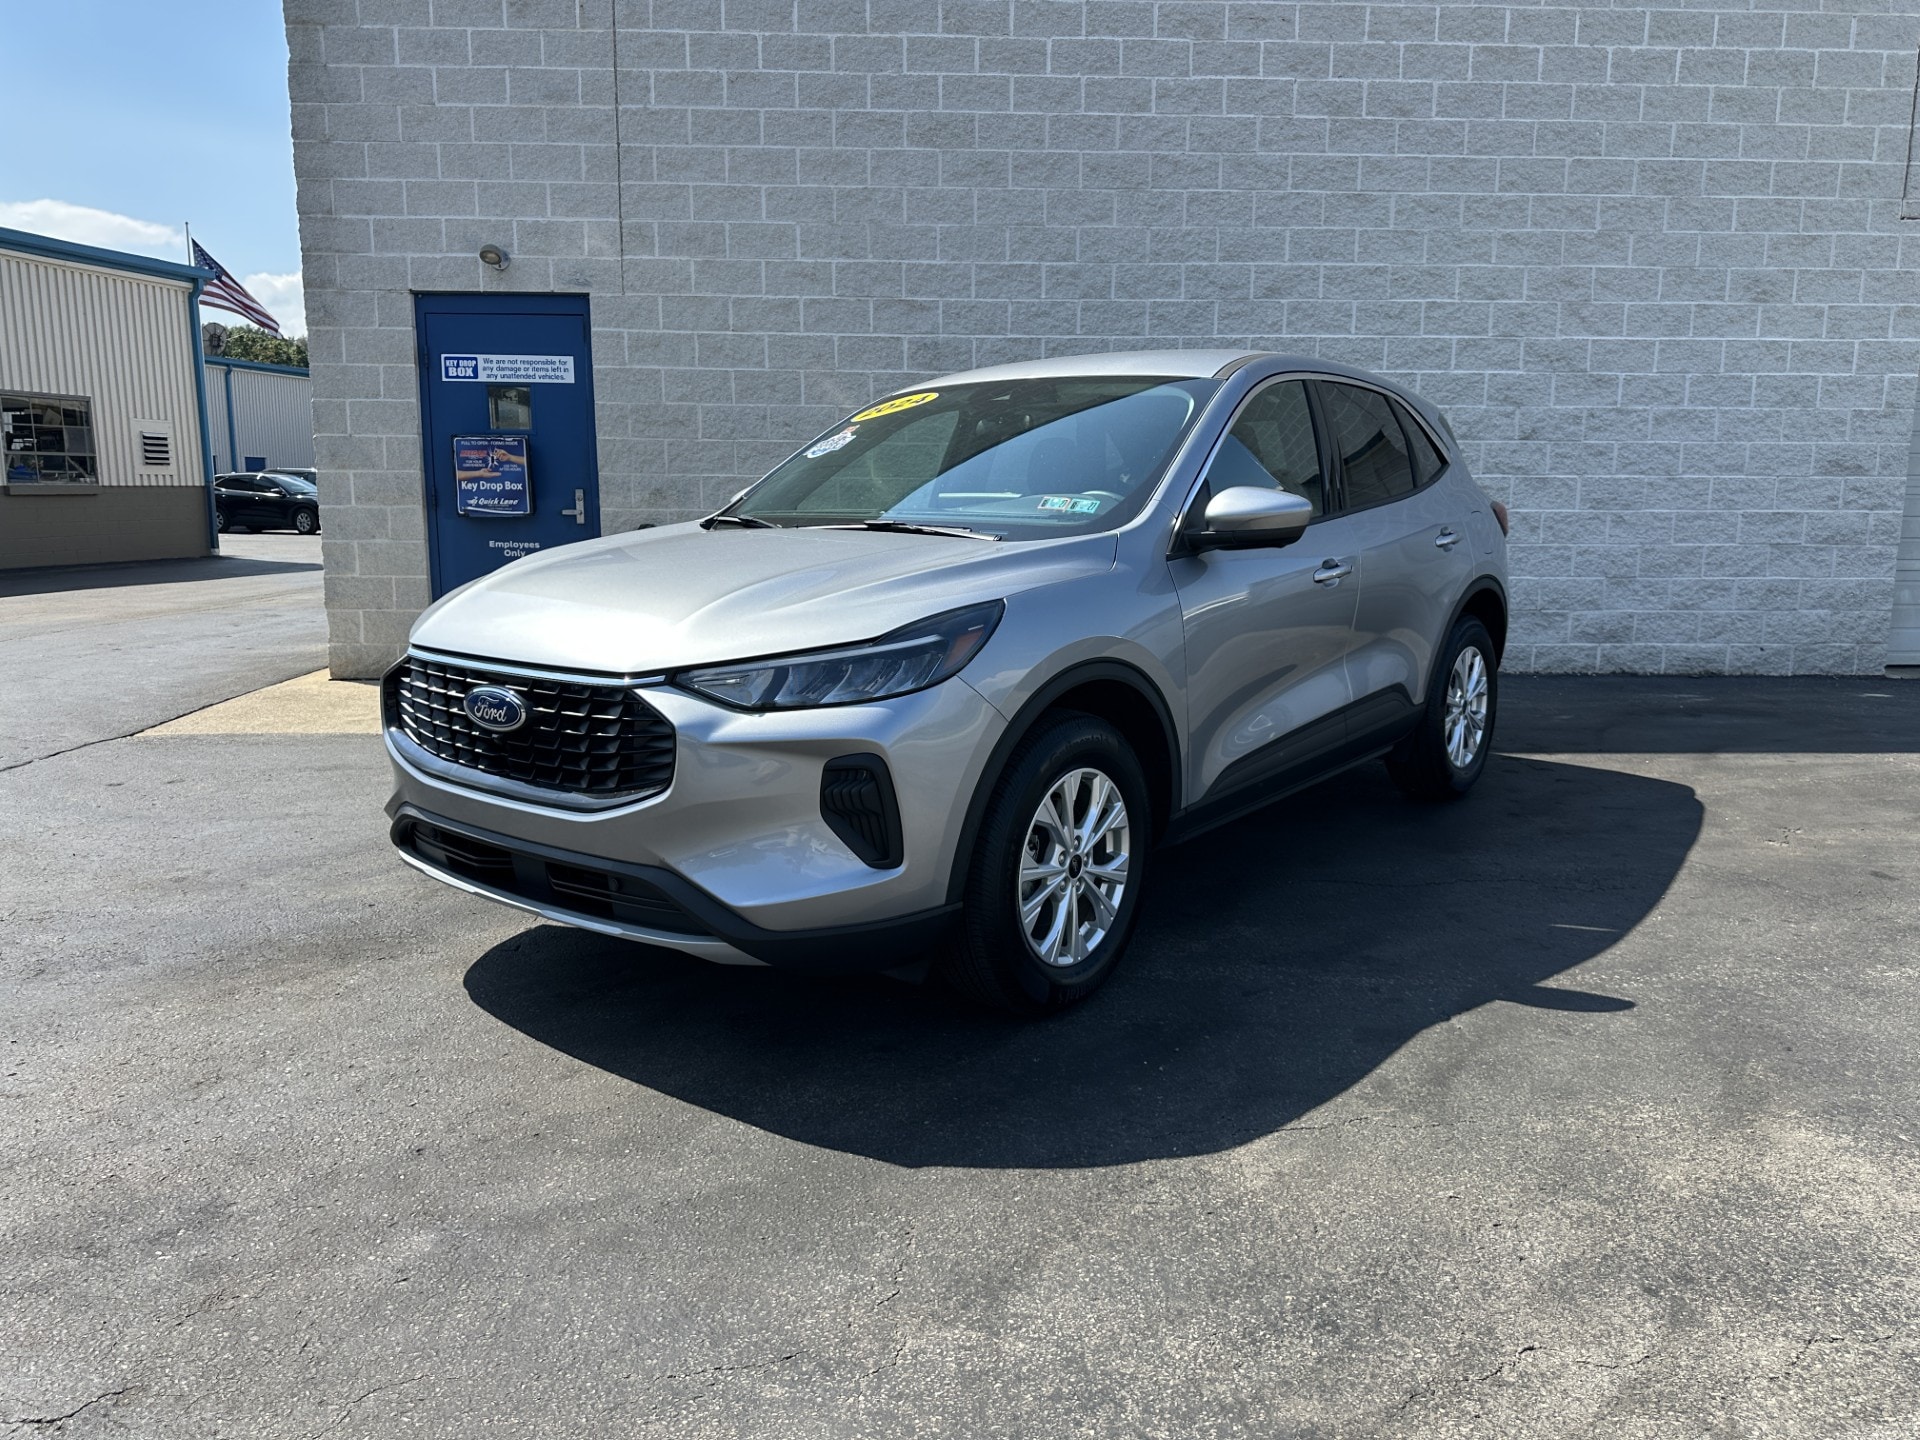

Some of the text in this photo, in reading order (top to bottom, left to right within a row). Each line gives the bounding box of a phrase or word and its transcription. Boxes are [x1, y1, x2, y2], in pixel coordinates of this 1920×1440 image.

[520, 359, 556, 367] responsible
[448, 367, 474, 377] BOX
[496, 365, 522, 373] damage
[857, 394, 932, 420] 2024
[461, 481, 523, 492] Key Drop Box
[478, 497, 499, 505] Quick
[489, 540, 540, 550] Employees
[504, 549, 526, 558] Only
[474, 696, 507, 722] Ford
